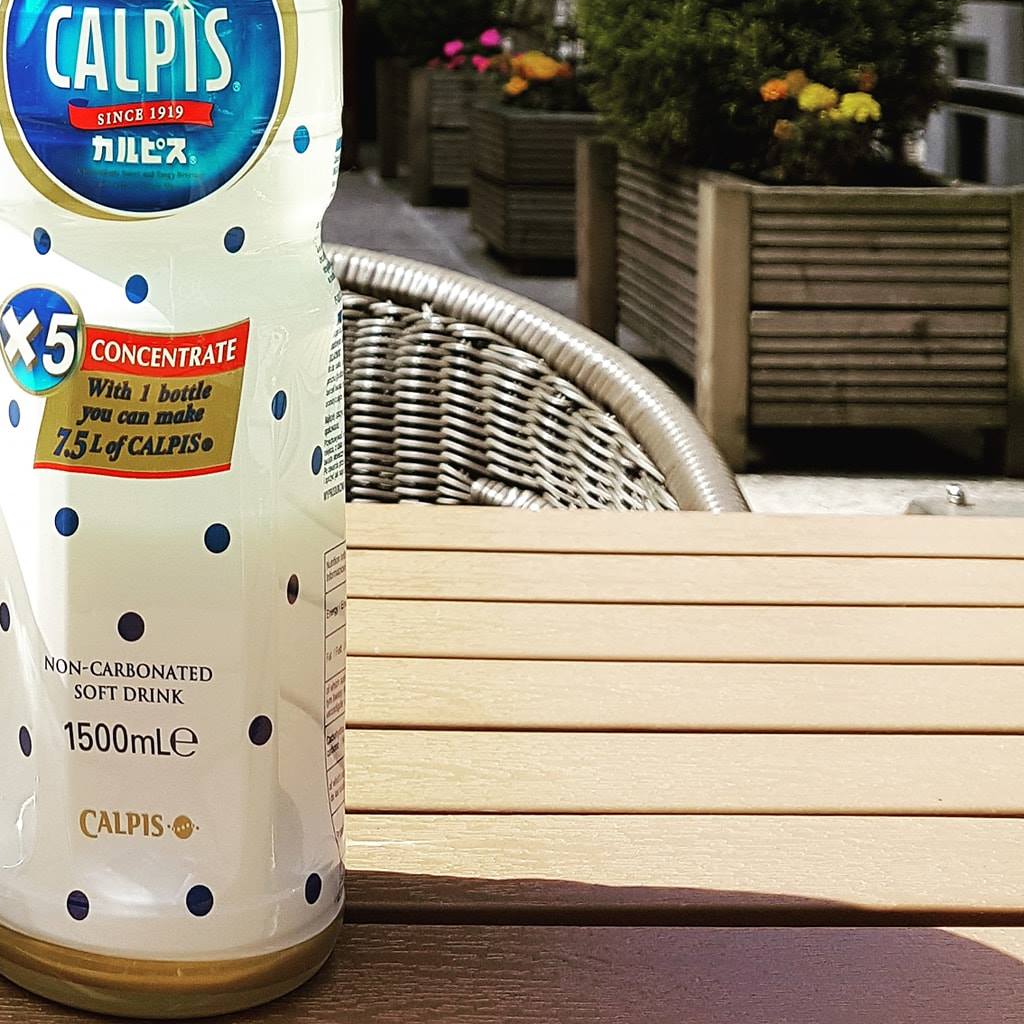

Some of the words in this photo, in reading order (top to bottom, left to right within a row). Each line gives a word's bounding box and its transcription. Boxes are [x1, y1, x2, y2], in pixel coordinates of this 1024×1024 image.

[45, 5, 232, 93] CALPIS
[97, 108, 144, 126] SINCE
[150, 105, 184, 119] 1919
[92, 135, 187, 164] カルピス
[0, 305, 79, 376] X5
[91, 337, 237, 367] CONCENTRATE
[87, 376, 132, 401] With
[139, 380, 150, 402] 1
[158, 378, 213, 403] bottle
[76, 405, 114, 426] you
[117, 409, 150, 425] can
[154, 403, 206, 425] make
[90, 436, 102, 454] L
[105, 435, 127, 462] of
[44, 655, 213, 682] NON-CARBONATED
[74, 683, 118, 701] SOFT
[123, 686, 184, 705] DRINK
[79, 809, 164, 839] CALPIS
